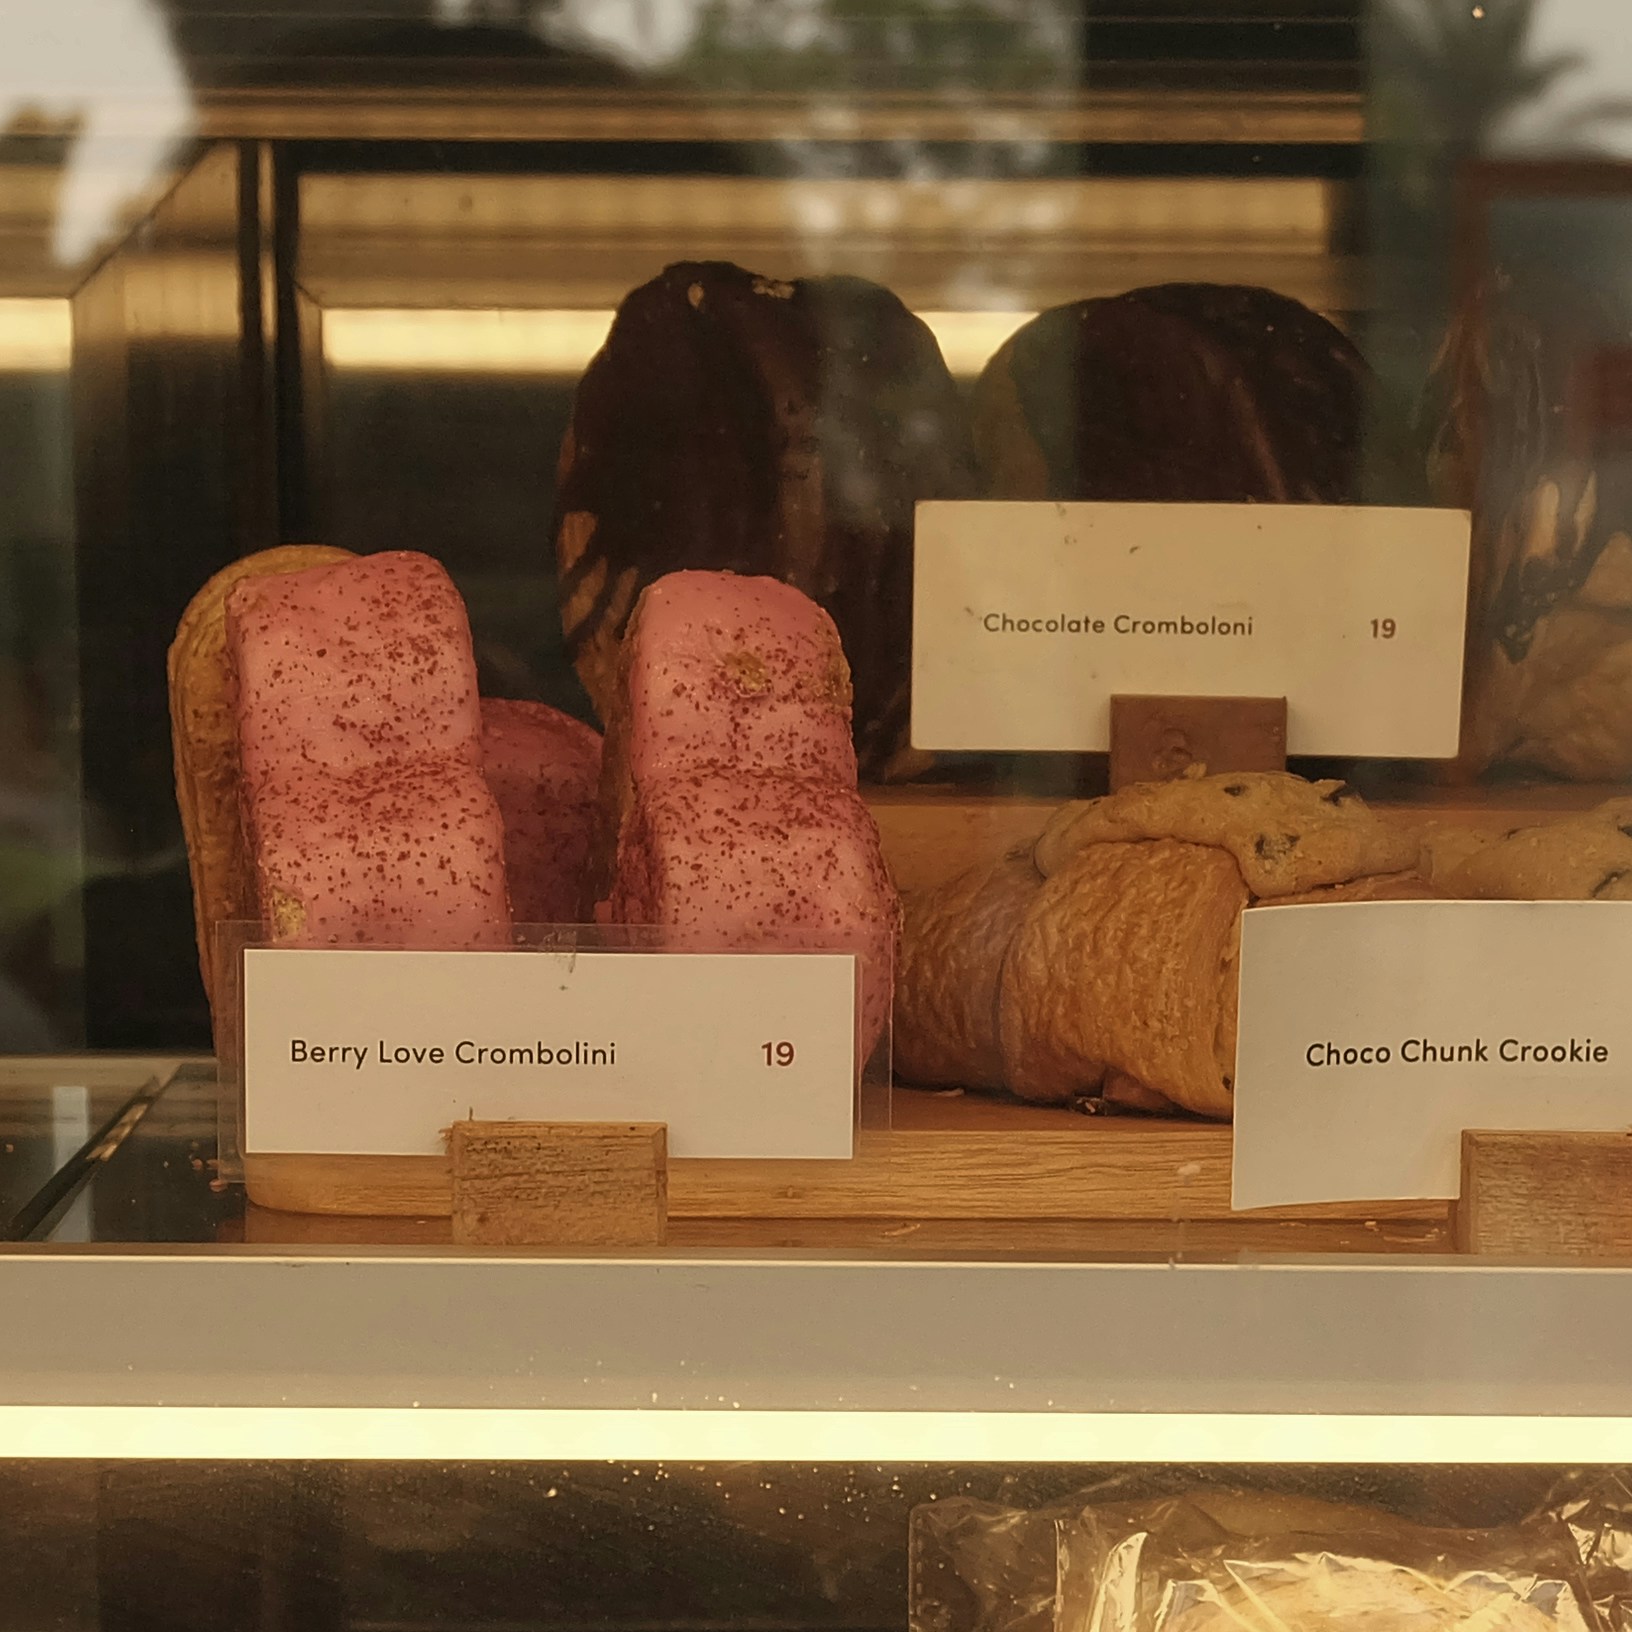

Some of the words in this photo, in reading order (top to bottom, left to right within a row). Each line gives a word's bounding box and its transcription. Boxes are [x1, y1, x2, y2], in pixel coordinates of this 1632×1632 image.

[983, 612, 1106, 634] Chocolate
[1113, 614, 1253, 636] Cromboloni
[1370, 618, 1397, 640] 19
[291, 1039, 368, 1070] Berry
[379, 1040, 445, 1064] Love
[455, 1040, 616, 1065] Crombolini
[761, 1041, 795, 1067] 19
[1306, 1041, 1391, 1067] Choco
[1400, 1038, 1489, 1063] Chunk
[1499, 1038, 1609, 1063] Crookie
